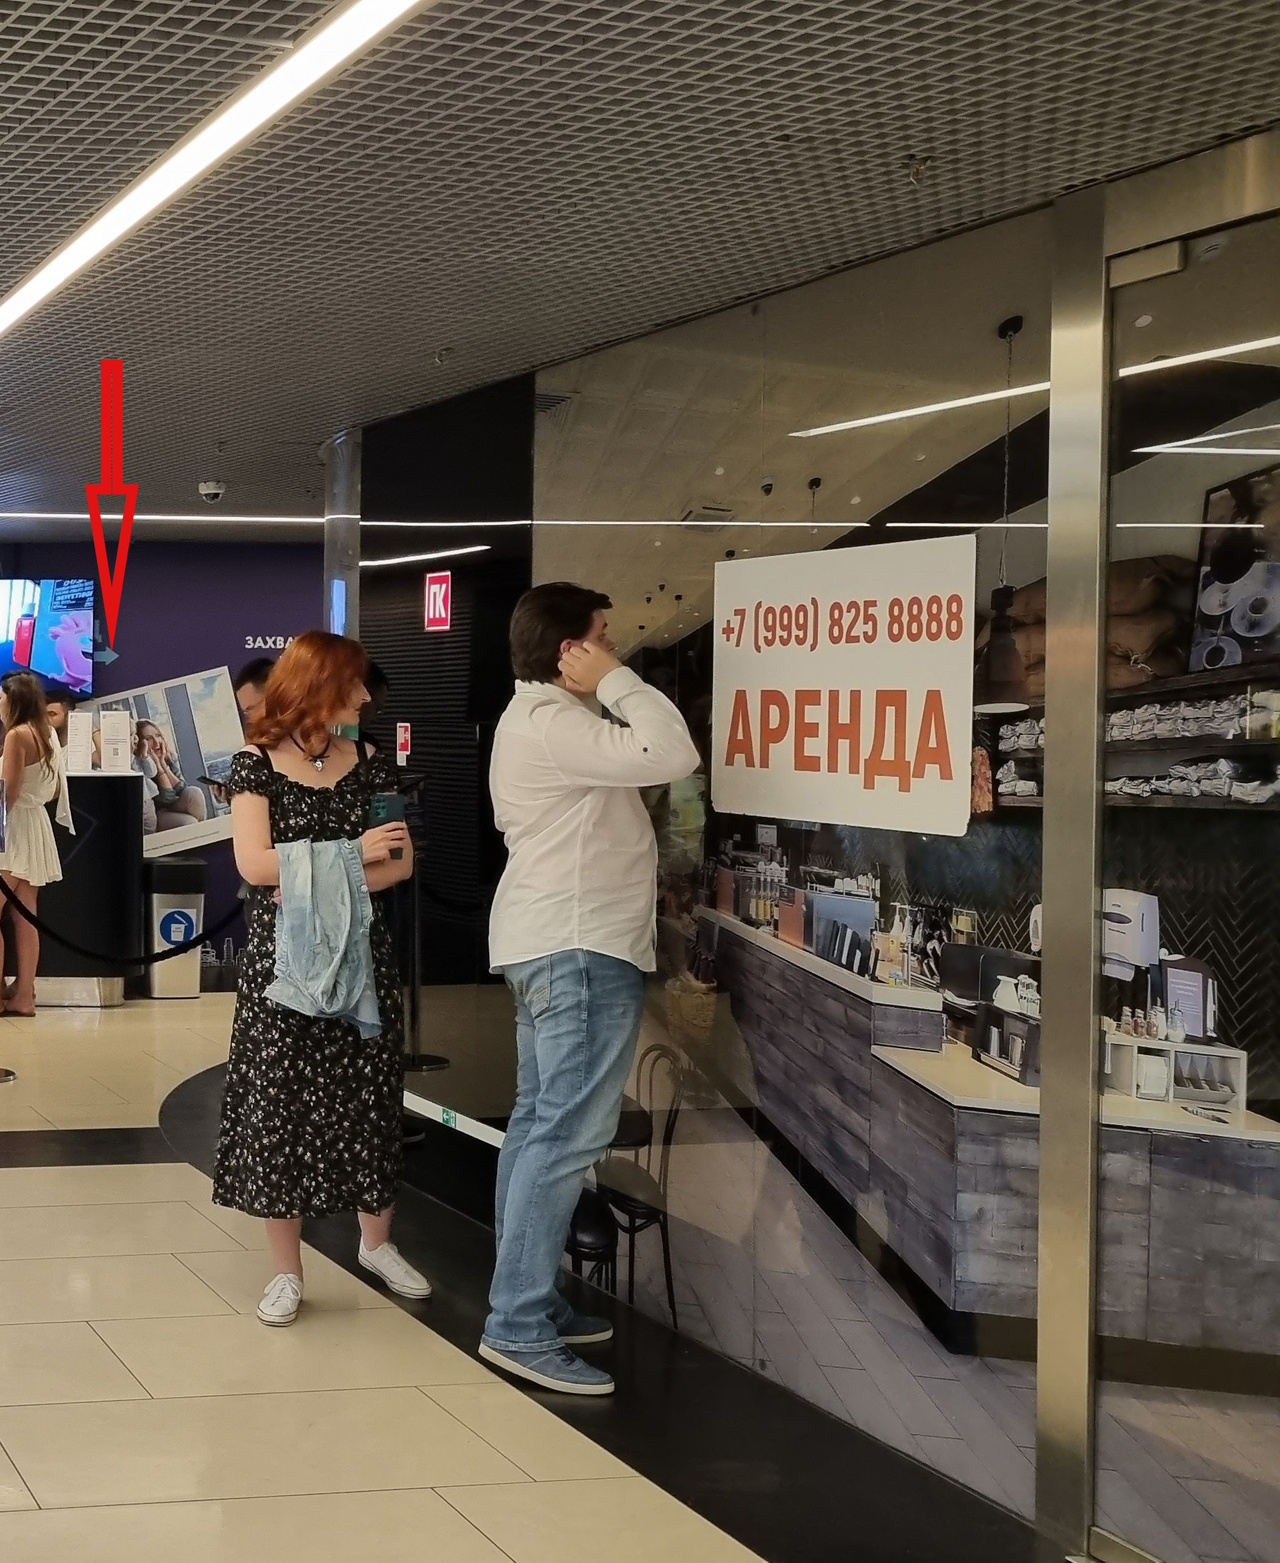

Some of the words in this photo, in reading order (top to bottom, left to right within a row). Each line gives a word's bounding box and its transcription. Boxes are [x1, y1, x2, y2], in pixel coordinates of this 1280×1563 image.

[429, 583, 447, 618] ПК
[722, 607, 747, 648] +7
[753, 596, 819, 653] (999)
[828, 600, 878, 645] 825
[887, 593, 963, 643] 8888
[245, 635, 297, 649] ЗАХВА
[725, 689, 954, 793] АРЕНДА
